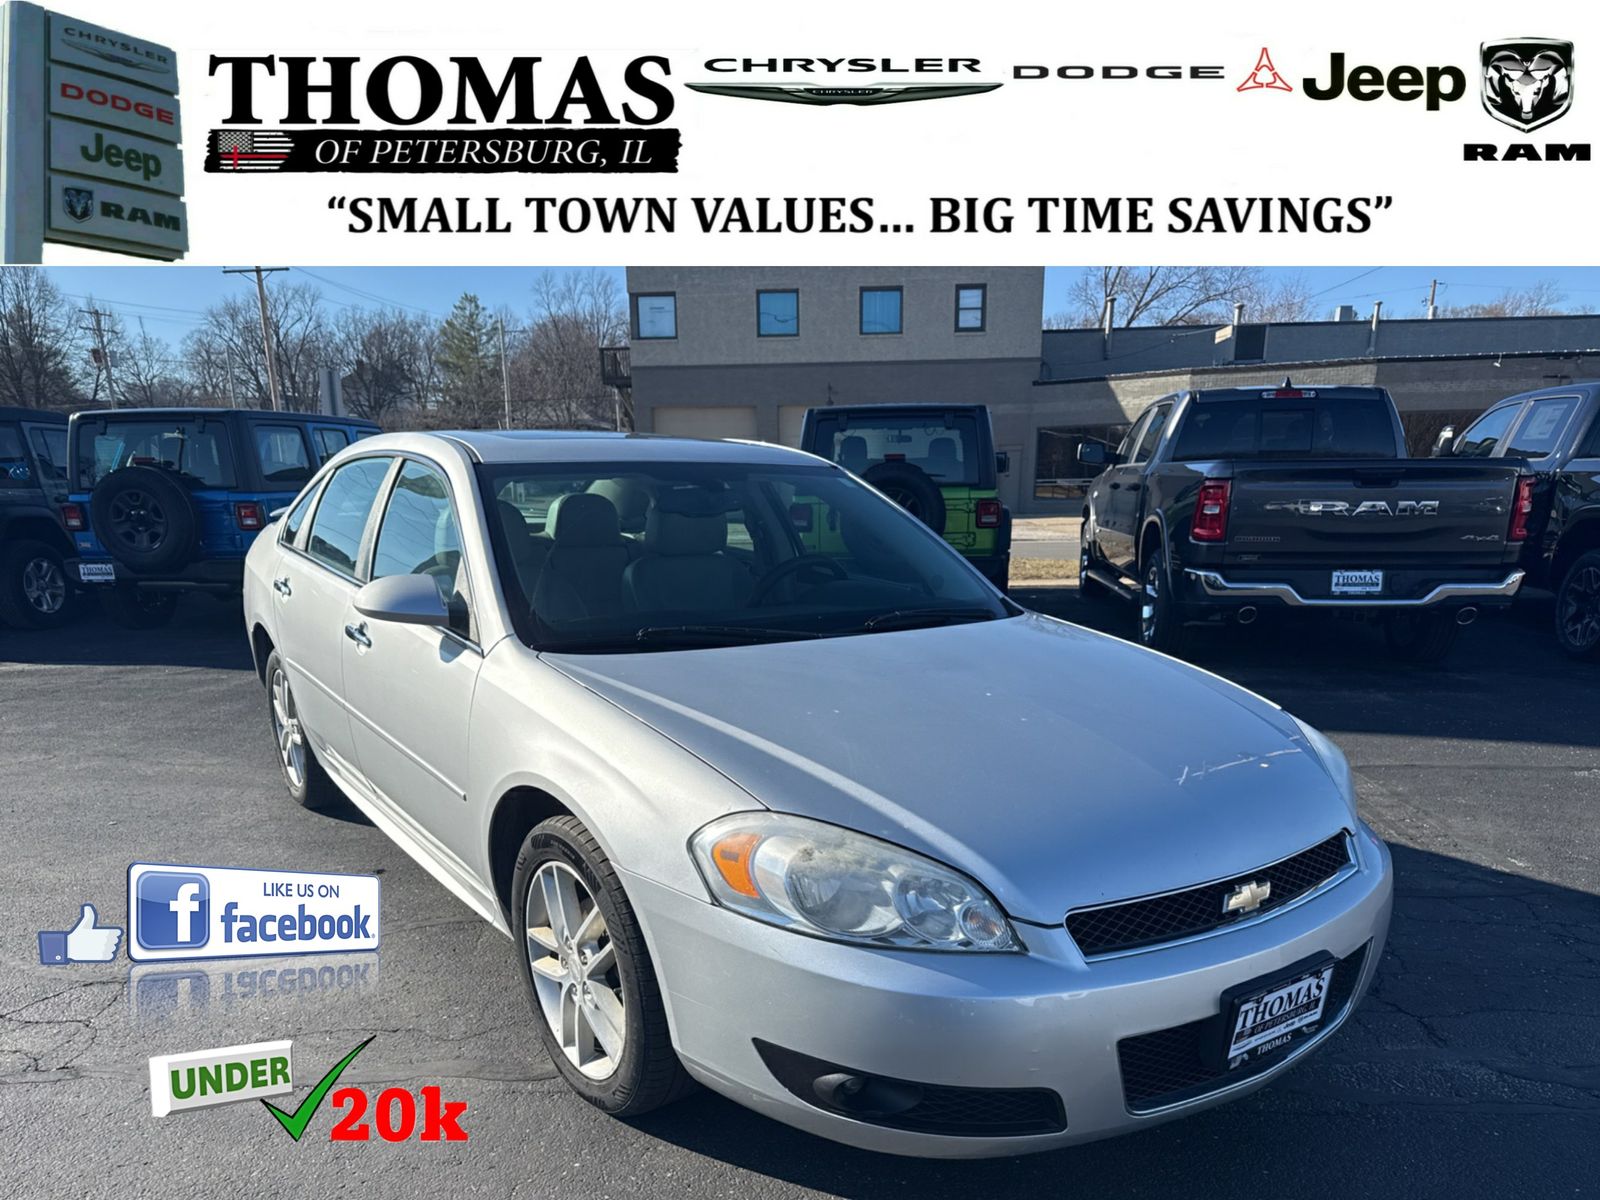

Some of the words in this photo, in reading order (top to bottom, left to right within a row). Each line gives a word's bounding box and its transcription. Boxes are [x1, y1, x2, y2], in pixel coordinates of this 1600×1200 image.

[1299, 500, 1440, 517] RAM
[1335, 575, 1380, 583] THOMAS
[1240, 977, 1325, 1029] THOMAS
[1257, 1033, 1292, 1055] THOMAS
